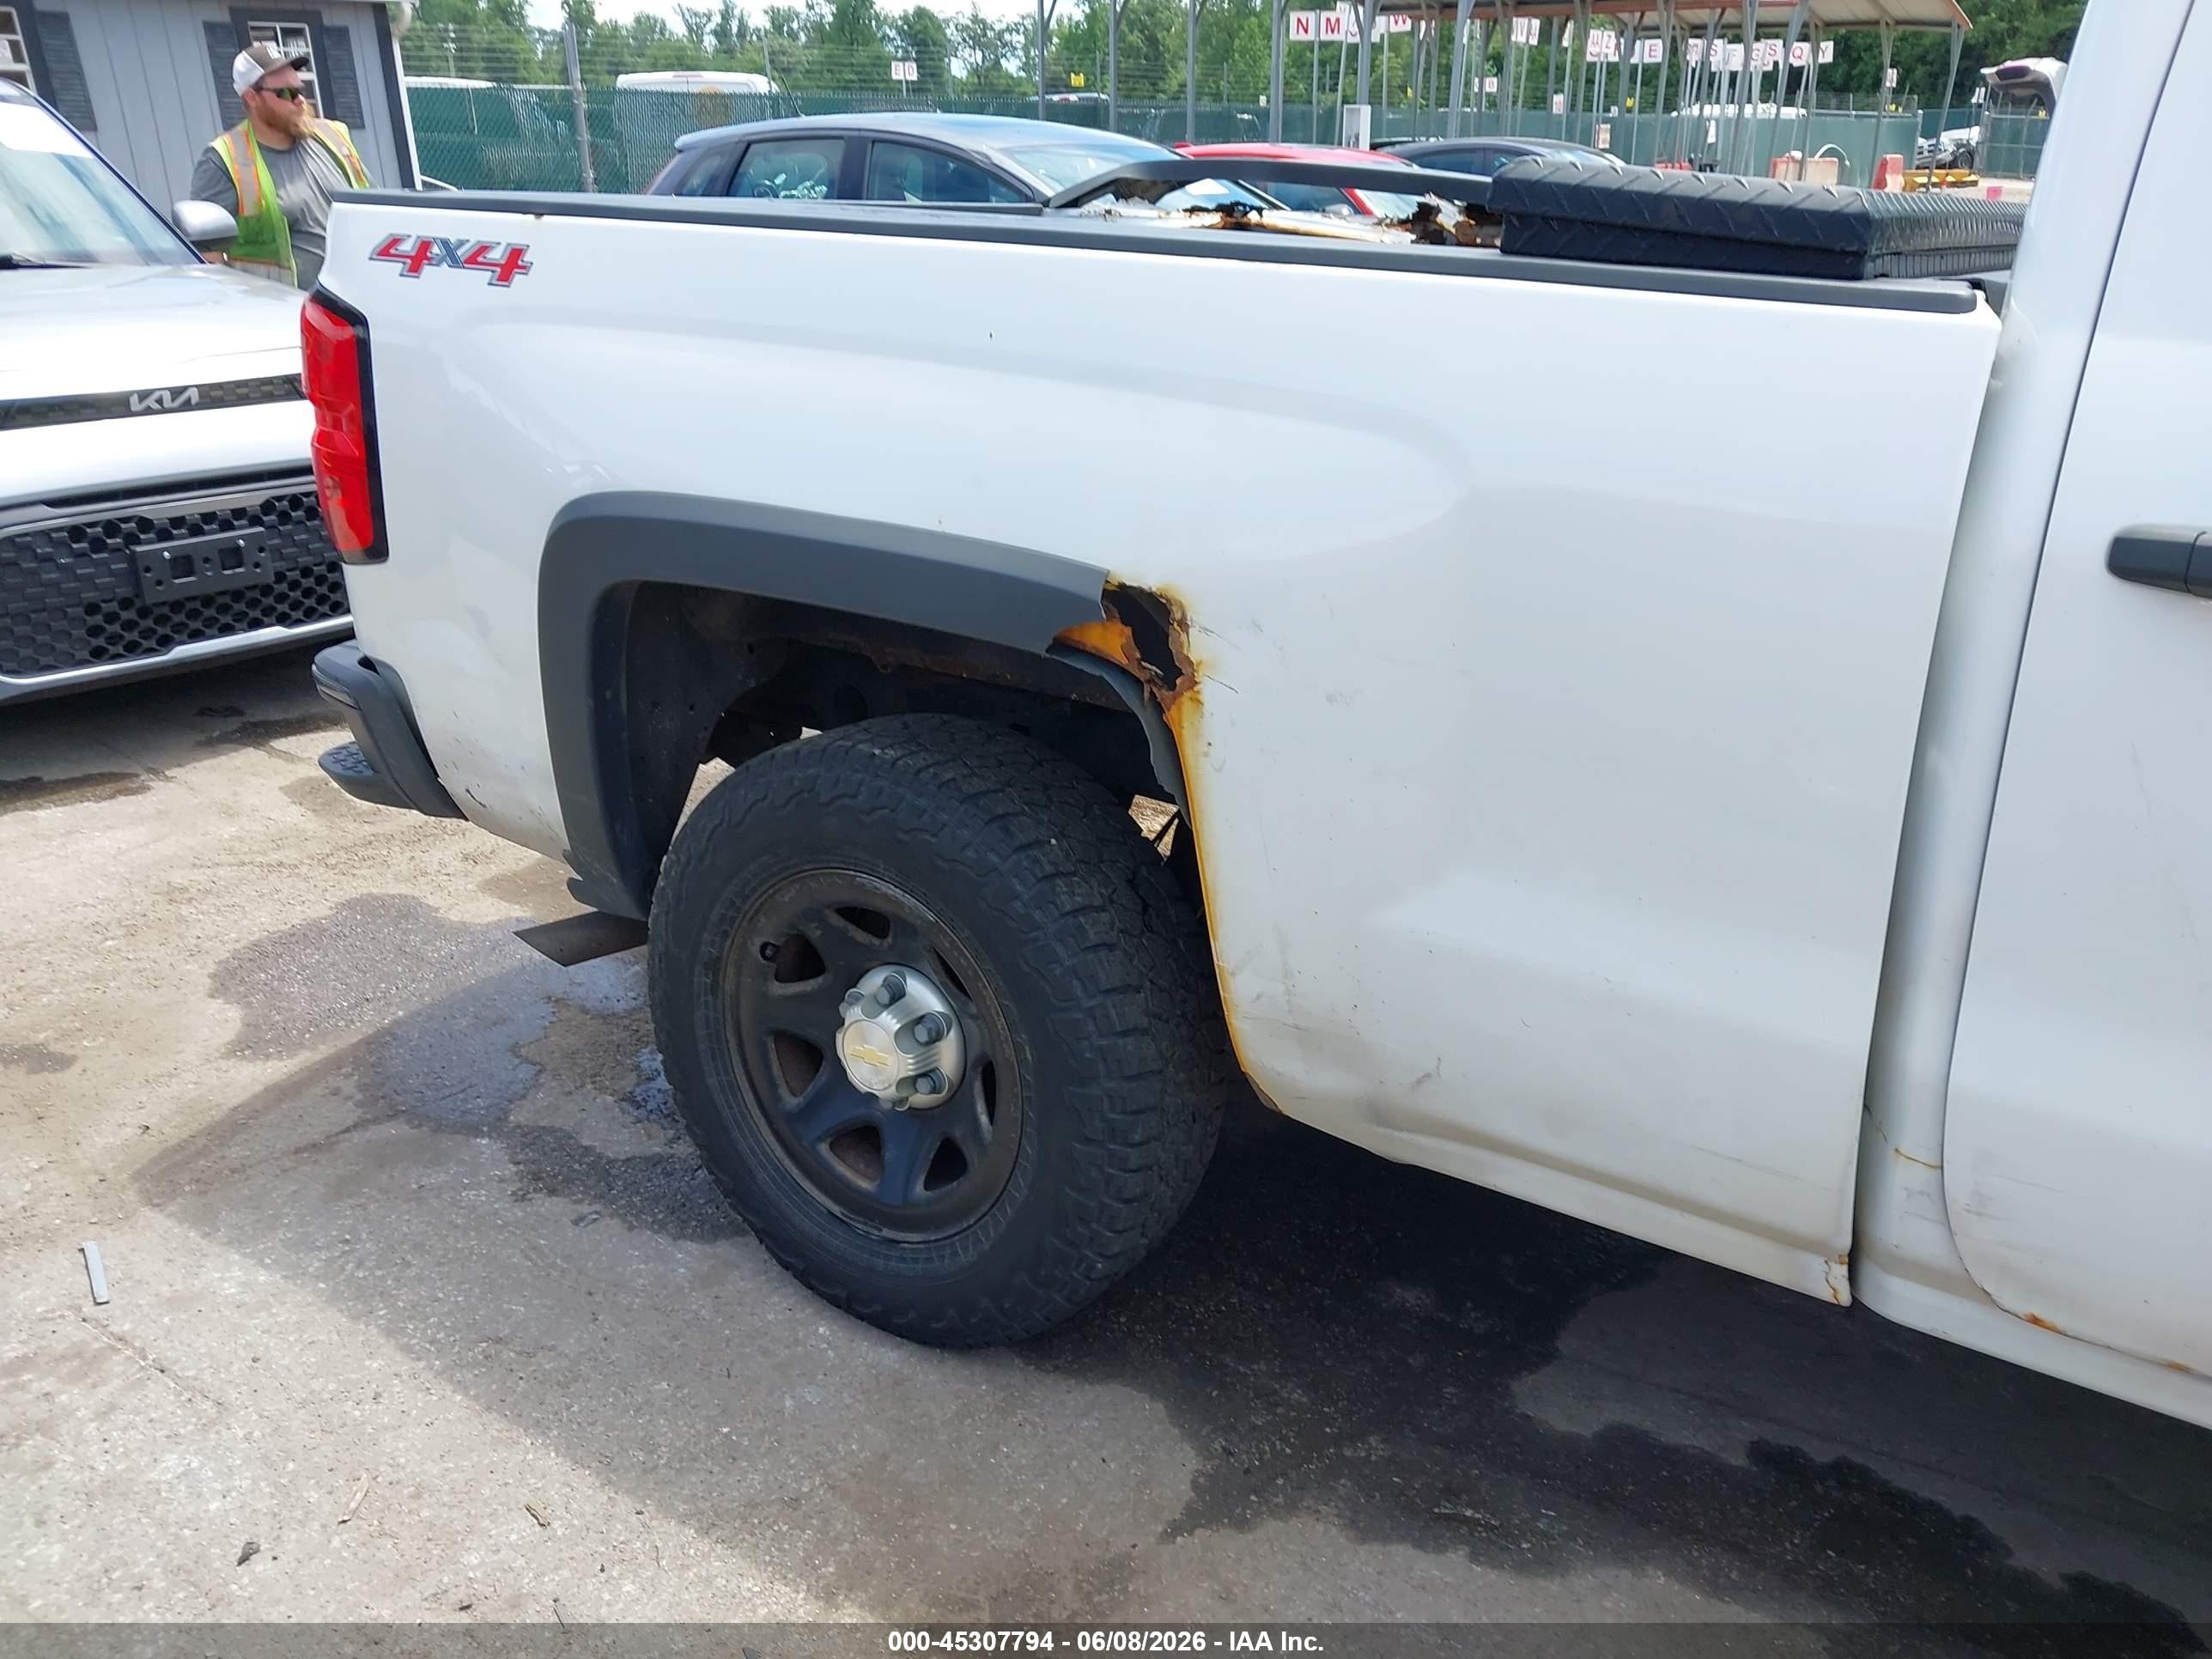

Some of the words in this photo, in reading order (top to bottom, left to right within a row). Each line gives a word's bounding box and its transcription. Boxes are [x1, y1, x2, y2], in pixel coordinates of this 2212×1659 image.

[1296, 16, 1310, 35] N
[1325, 16, 1340, 35] M
[1649, 43, 1658, 58] E
[1767, 43, 1778, 57] S
[1792, 46, 1803, 60] Q
[129, 386, 200, 412] KIA
